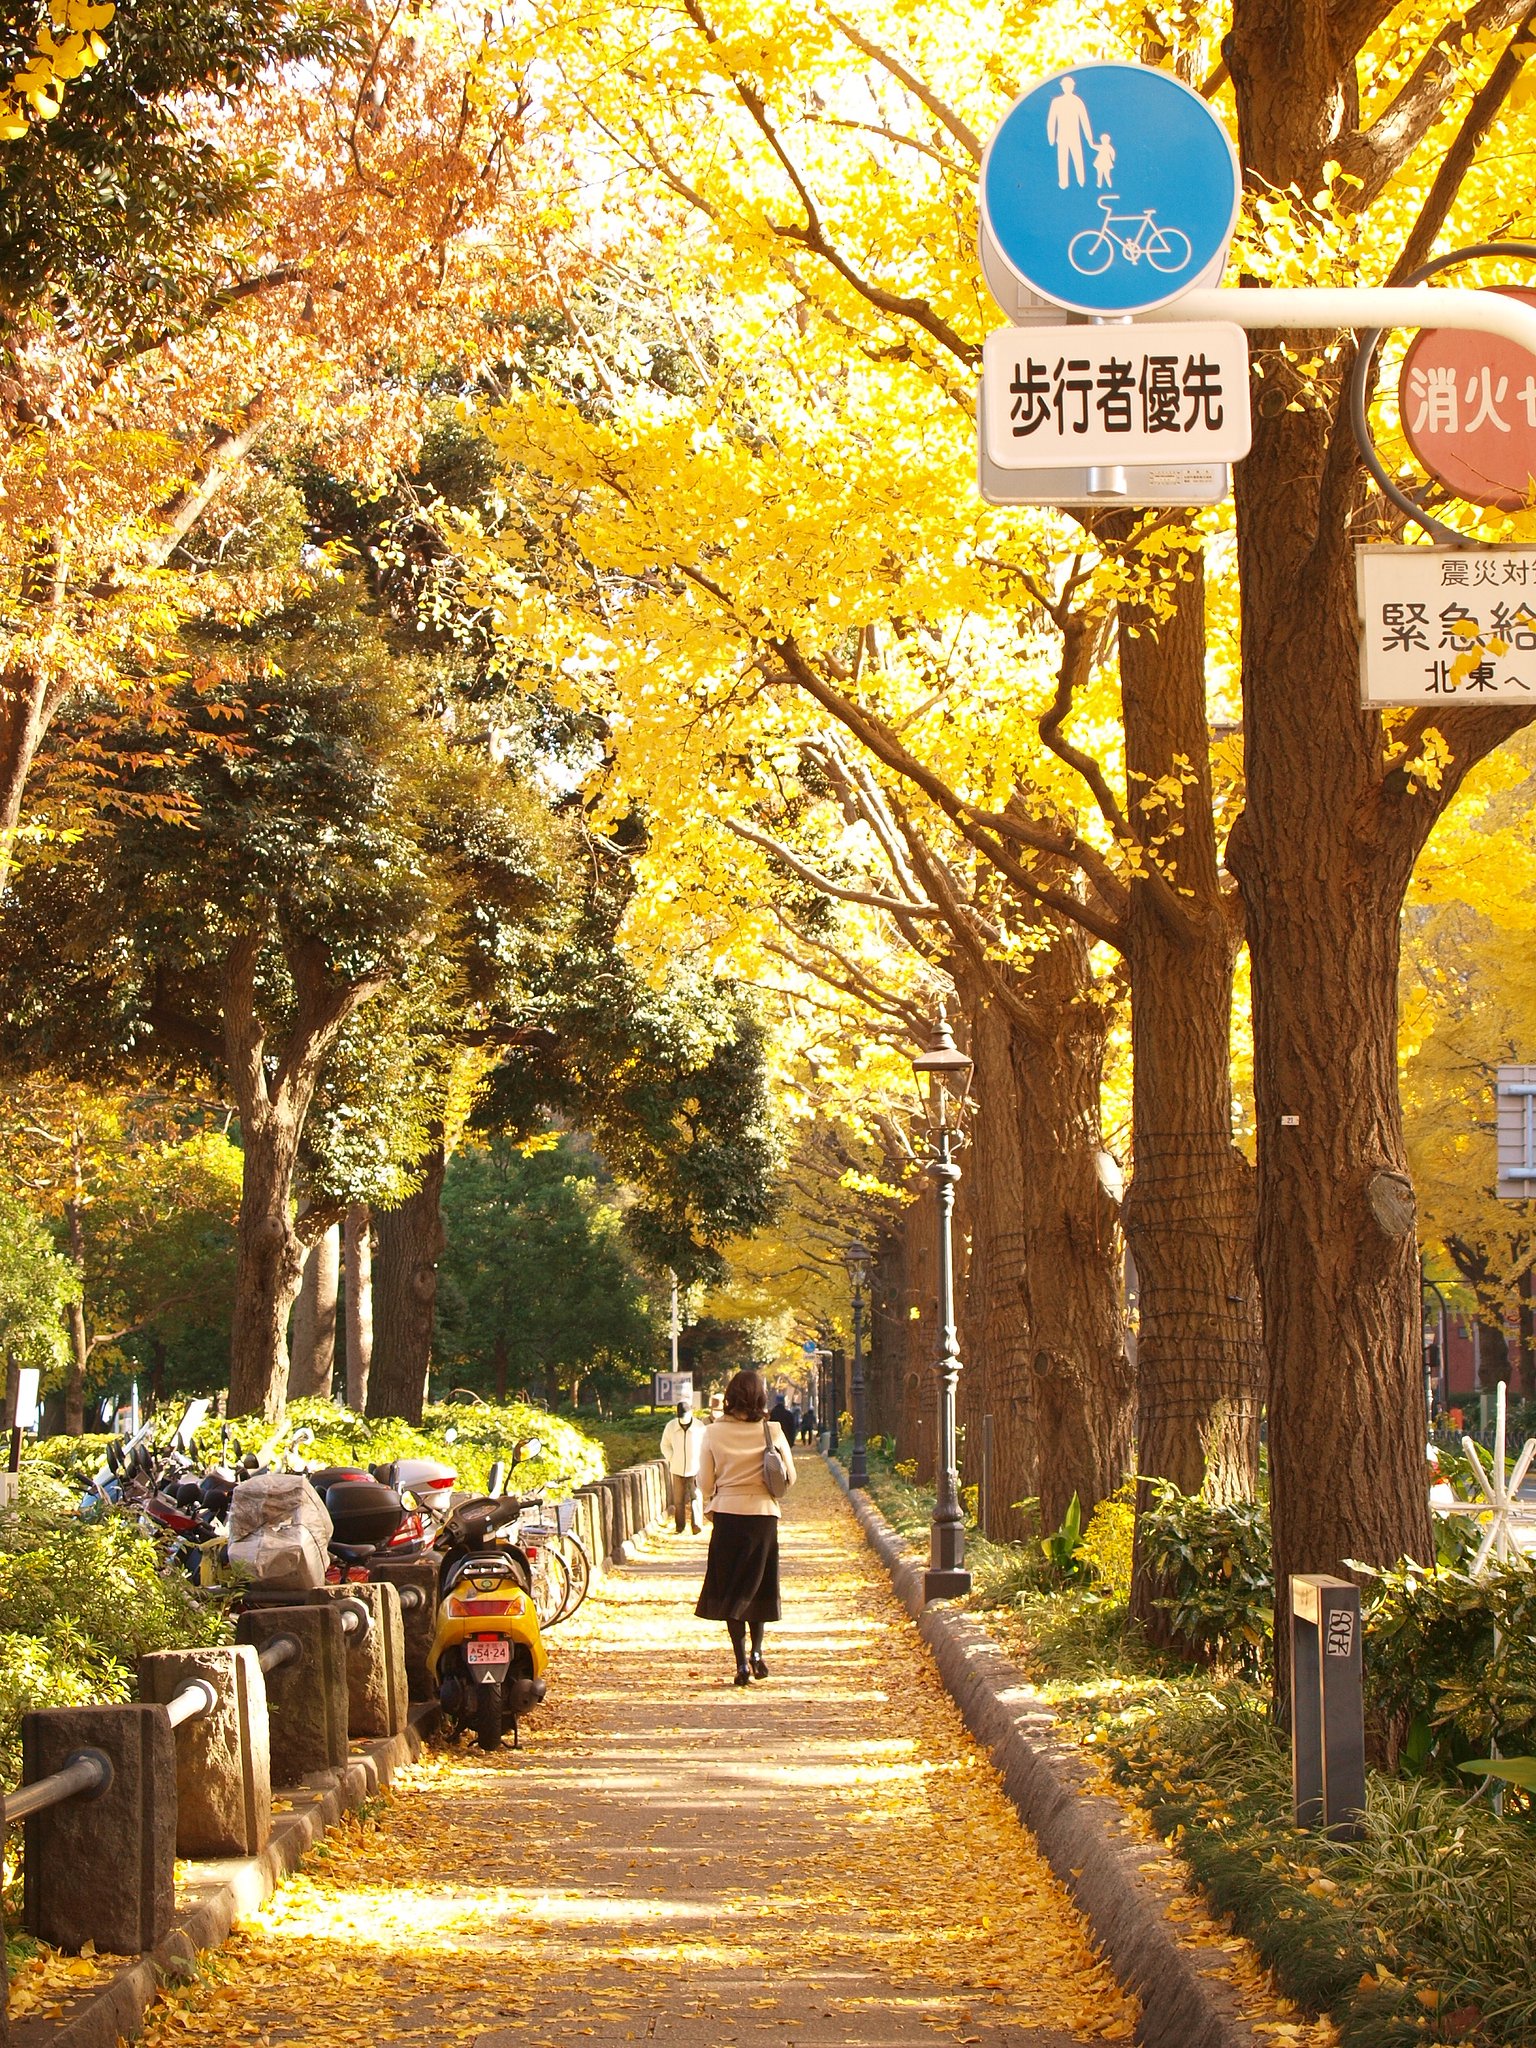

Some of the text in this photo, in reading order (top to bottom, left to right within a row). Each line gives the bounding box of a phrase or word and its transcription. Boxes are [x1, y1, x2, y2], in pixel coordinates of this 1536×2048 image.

[1010, 353, 1224, 437] 歩行者優先
[1441, 559, 1536, 587] 震災対
[1424, 660, 1531, 694] 北東へ
[661, 1380, 670, 1400] P
[477, 1648, 506, 1658] 54-24
